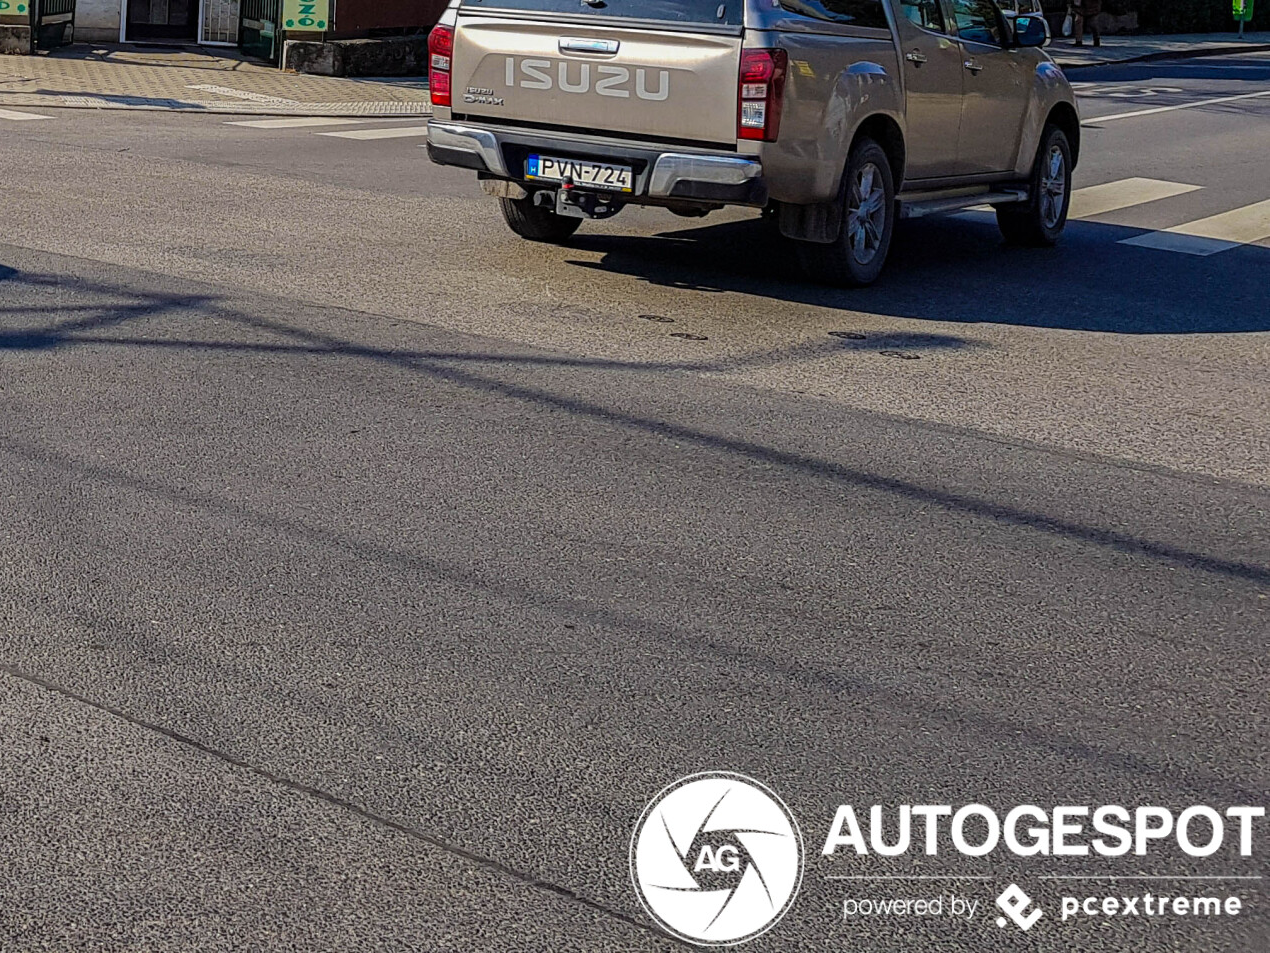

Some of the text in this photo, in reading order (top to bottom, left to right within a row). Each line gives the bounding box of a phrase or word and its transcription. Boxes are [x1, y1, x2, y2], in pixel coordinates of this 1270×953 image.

[505, 57, 669, 101] ISUZU
[463, 93, 504, 106] D-MAX
[466, 86, 493, 96] ISUZU
[542, 158, 627, 186] PVN-724
